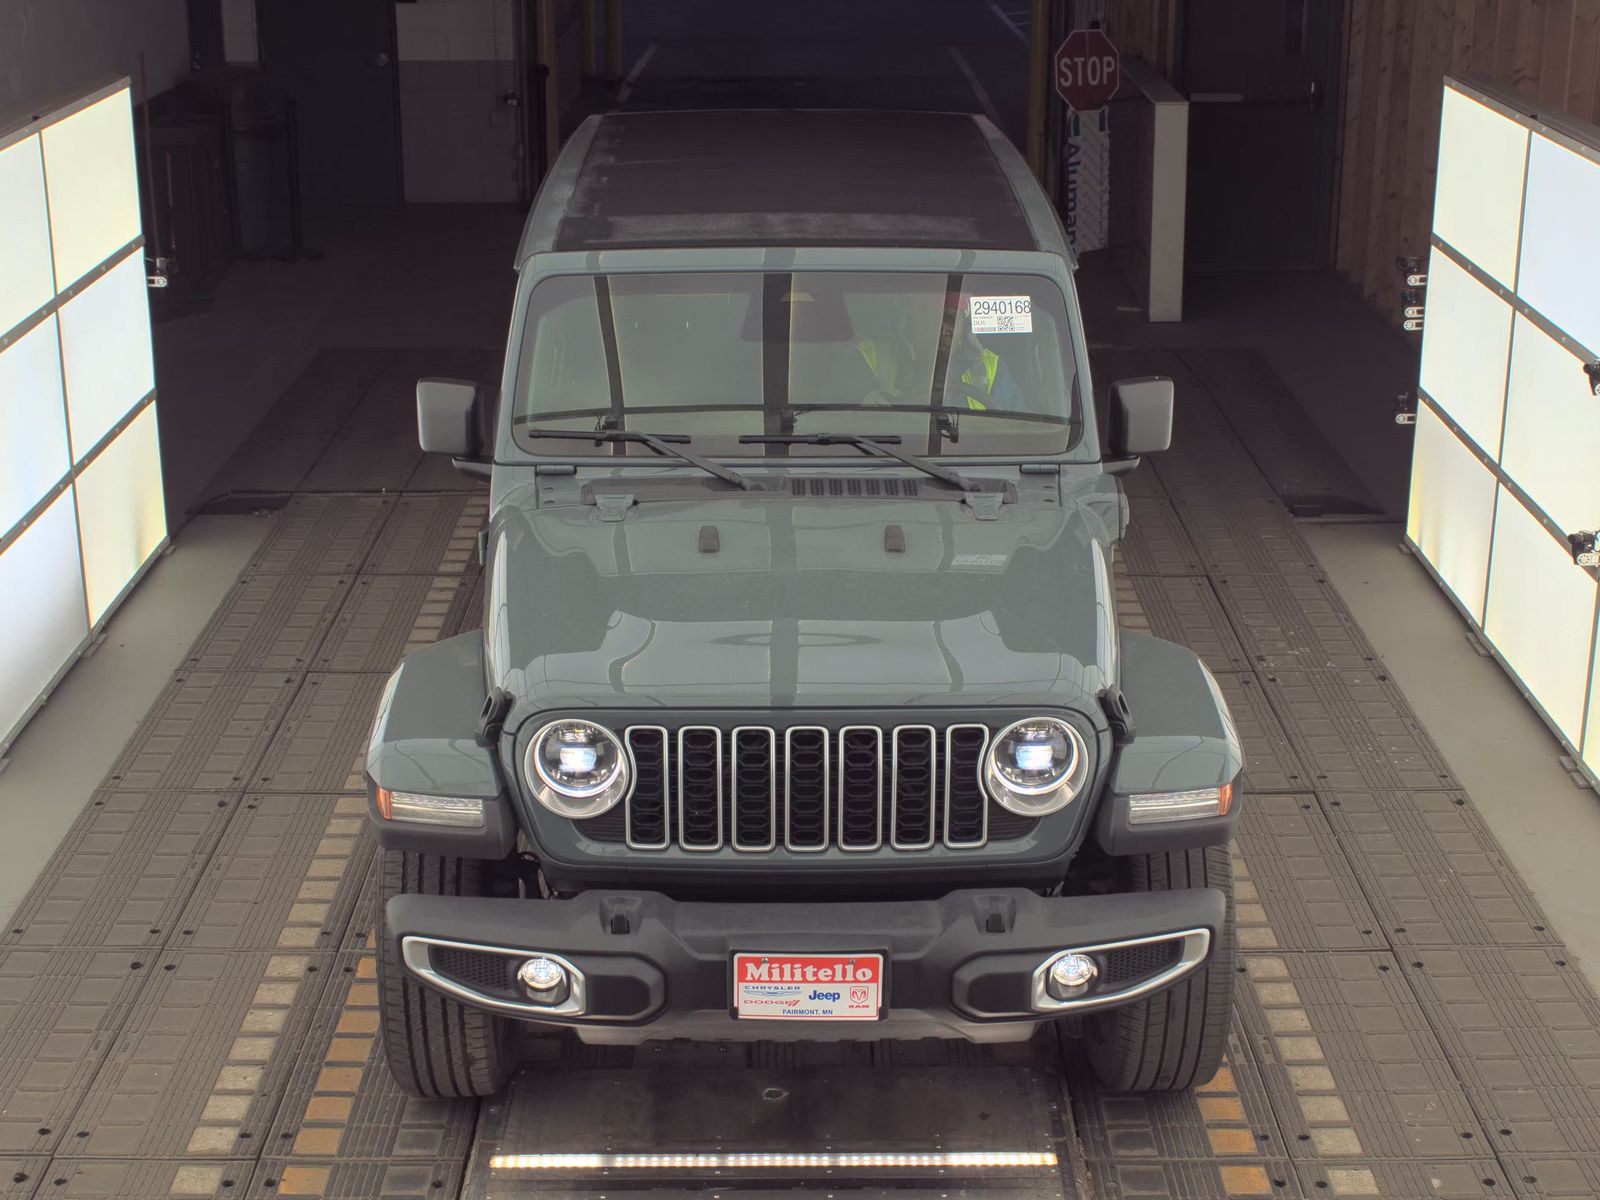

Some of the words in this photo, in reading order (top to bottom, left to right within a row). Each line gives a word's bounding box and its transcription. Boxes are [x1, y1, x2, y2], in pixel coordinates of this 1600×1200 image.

[1060, 56, 1115, 87] STOP
[974, 300, 1031, 314] 2940168
[745, 962, 873, 982] Militello
[808, 990, 841, 1002] Jeep
